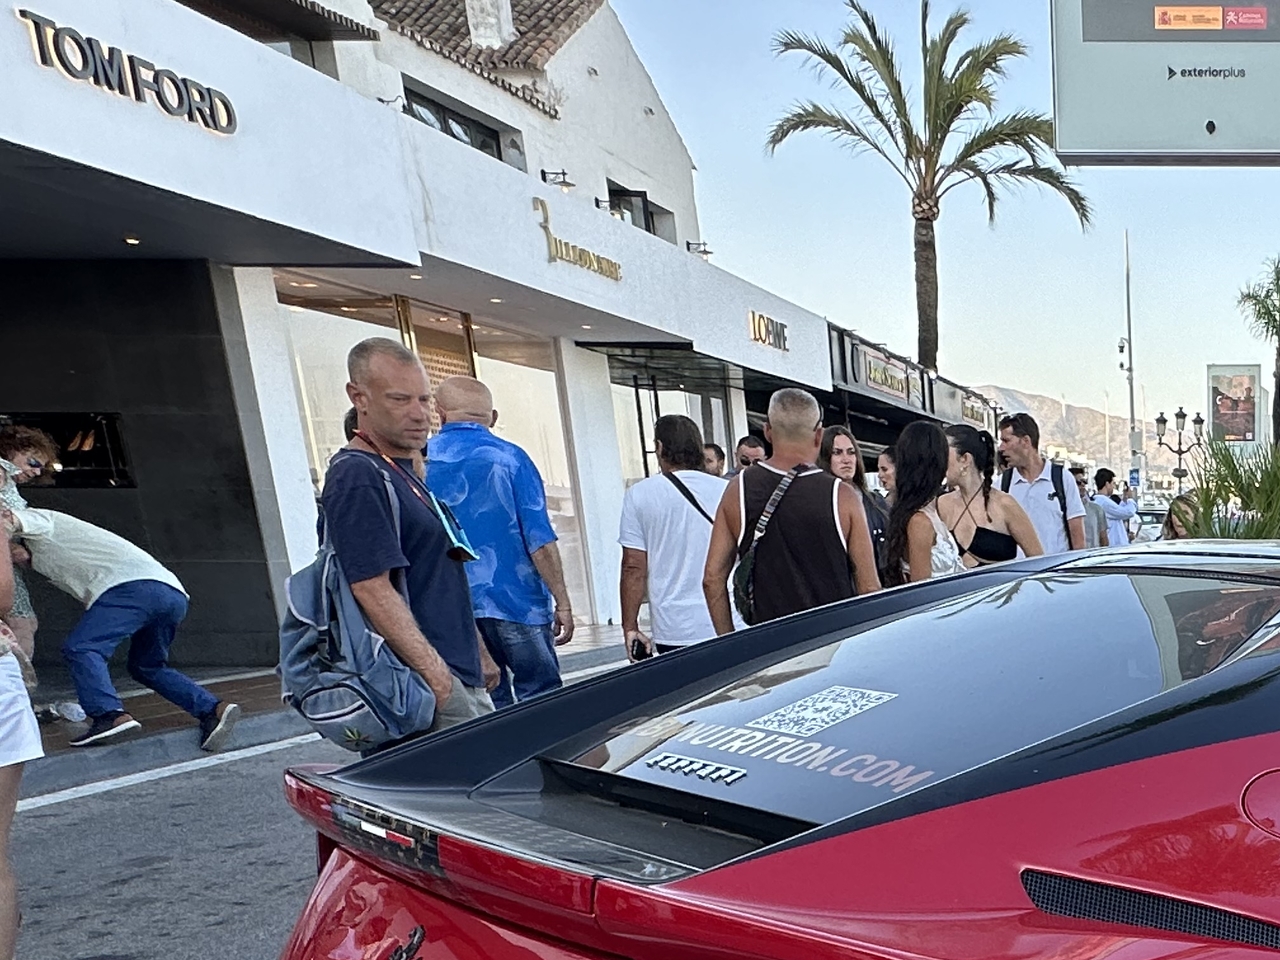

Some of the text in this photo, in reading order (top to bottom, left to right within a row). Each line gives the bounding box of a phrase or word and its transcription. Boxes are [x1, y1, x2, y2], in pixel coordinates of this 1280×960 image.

[19, 9, 238, 136] TOM FORD
[1180, 66, 1246, 80] exteriorplus
[750, 310, 789, 352] LOEWE
[645, 751, 748, 786] Ferrari
